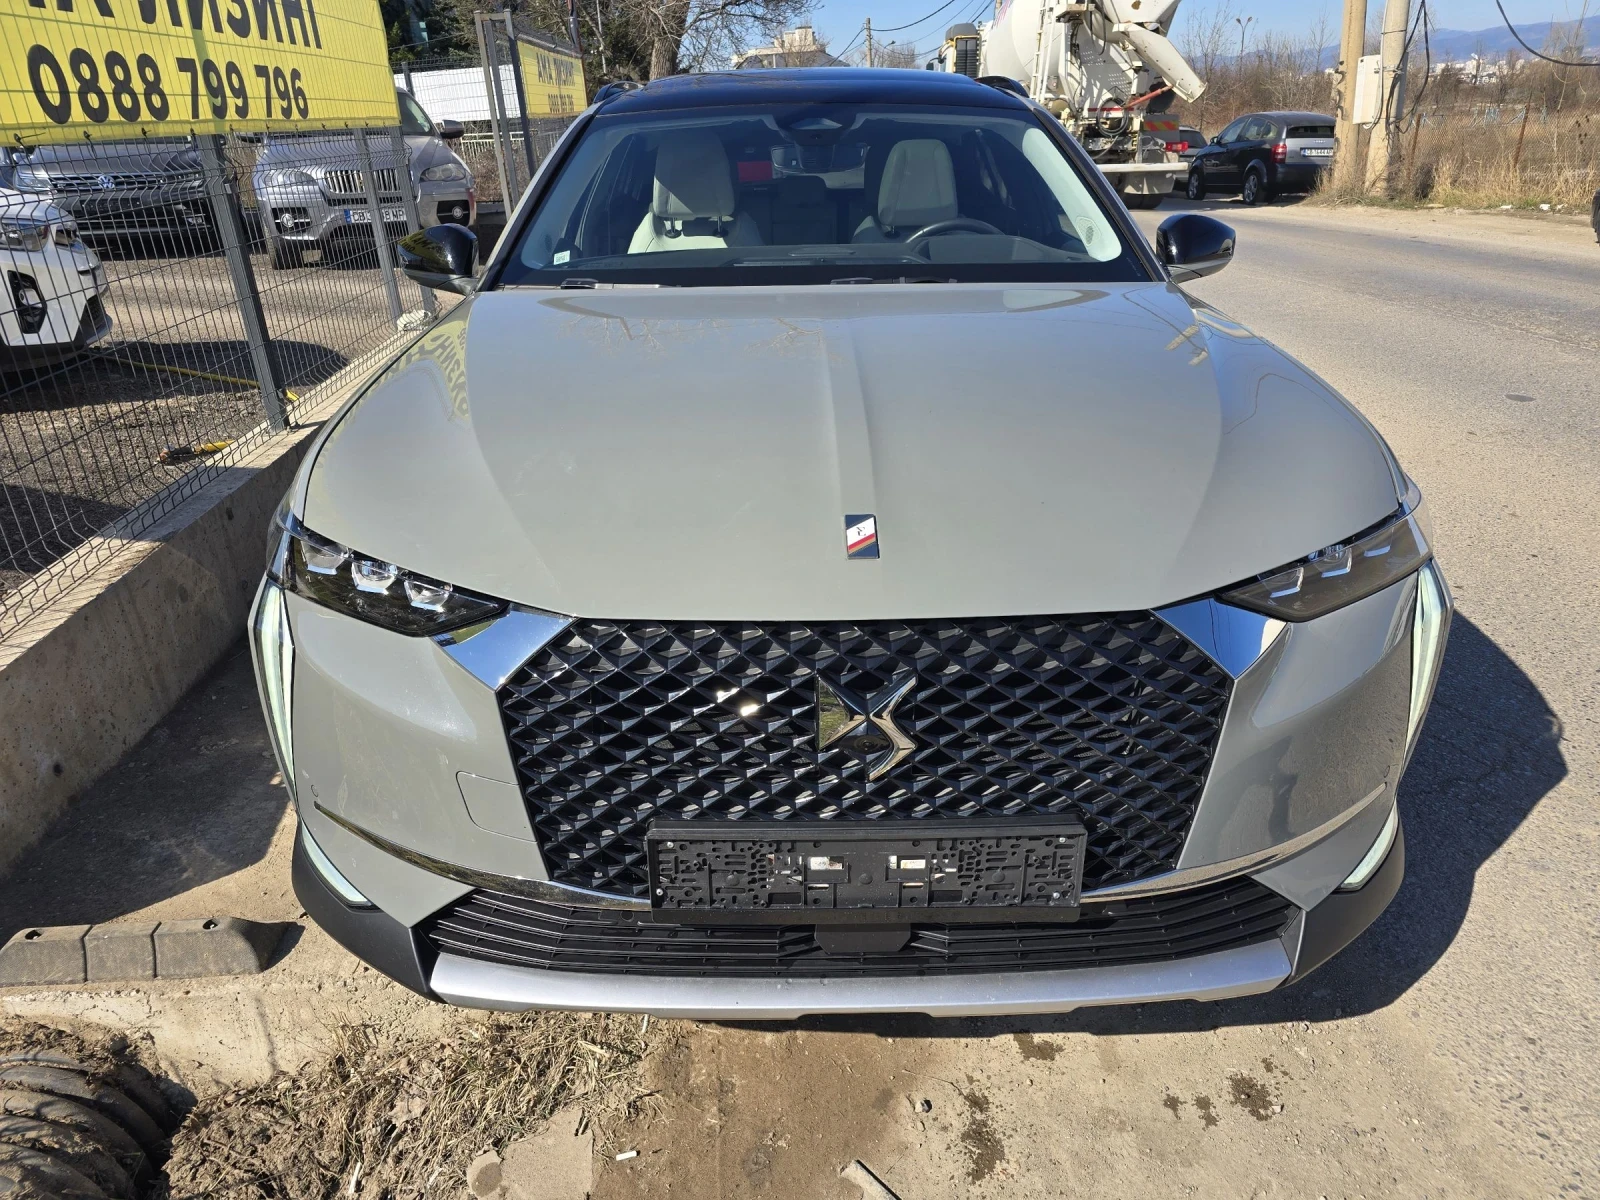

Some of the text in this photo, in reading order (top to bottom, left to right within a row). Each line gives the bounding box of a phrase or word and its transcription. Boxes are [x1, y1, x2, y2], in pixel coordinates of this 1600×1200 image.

[27, 44, 309, 125] 0888 799 796
